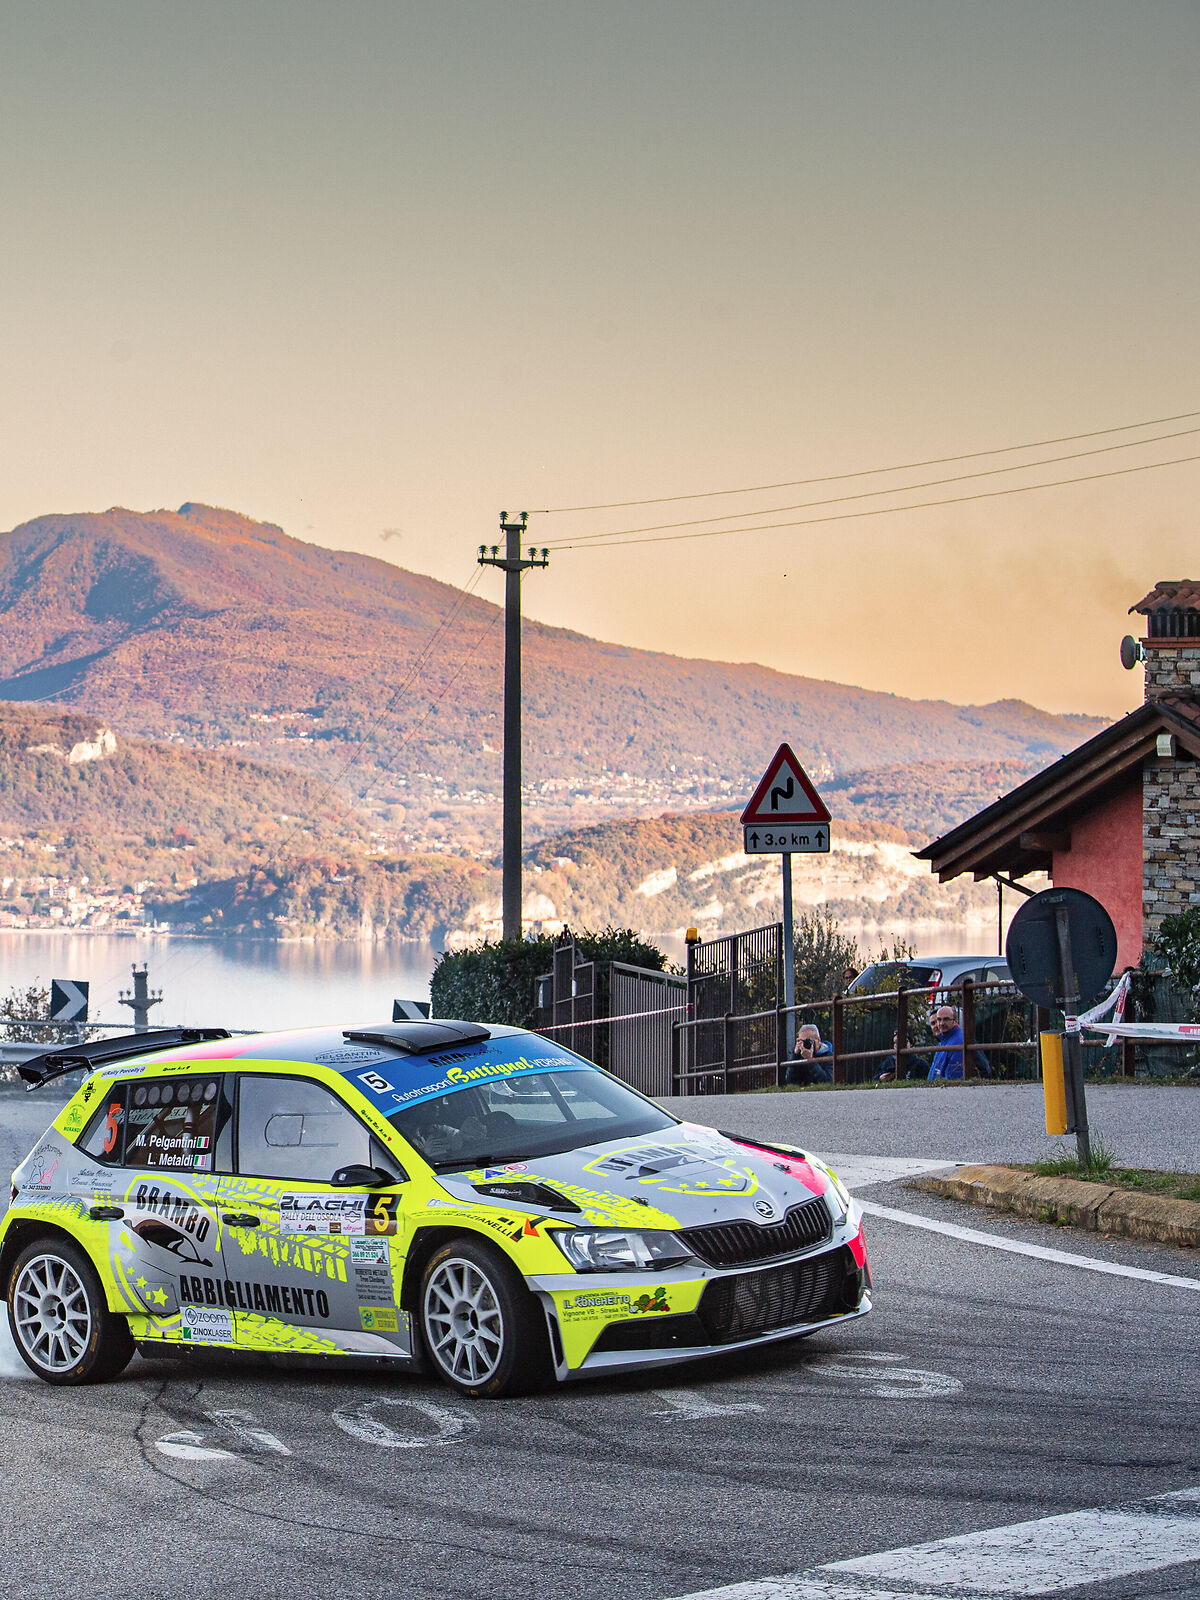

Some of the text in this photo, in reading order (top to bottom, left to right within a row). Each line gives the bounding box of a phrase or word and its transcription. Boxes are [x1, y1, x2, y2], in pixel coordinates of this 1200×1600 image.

[791, 833, 810, 845] km
[315, 1052, 381, 1061] PELGANTINI
[364, 1074, 388, 1090] 5
[392, 1056, 576, 1103] Autotrasporti Buttignol VERBANIA
[103, 1103, 120, 1153] 5
[136, 1135, 197, 1150] M. Pelgantini
[147, 1153, 194, 1167] L. Metaldi
[280, 1195, 365, 1211] 2LAGHI
[136, 1184, 210, 1243] BRAMBO
[281, 1212, 300, 1221] RALLY
[301, 1212, 341, 1222] DELL'OSSOLA
[373, 1197, 393, 1232] 5
[179, 1274, 330, 1319] ABBIGLIAMENTO
[564, 1300, 573, 1309] IL
[193, 1327, 232, 1338] ZINOXLASER
